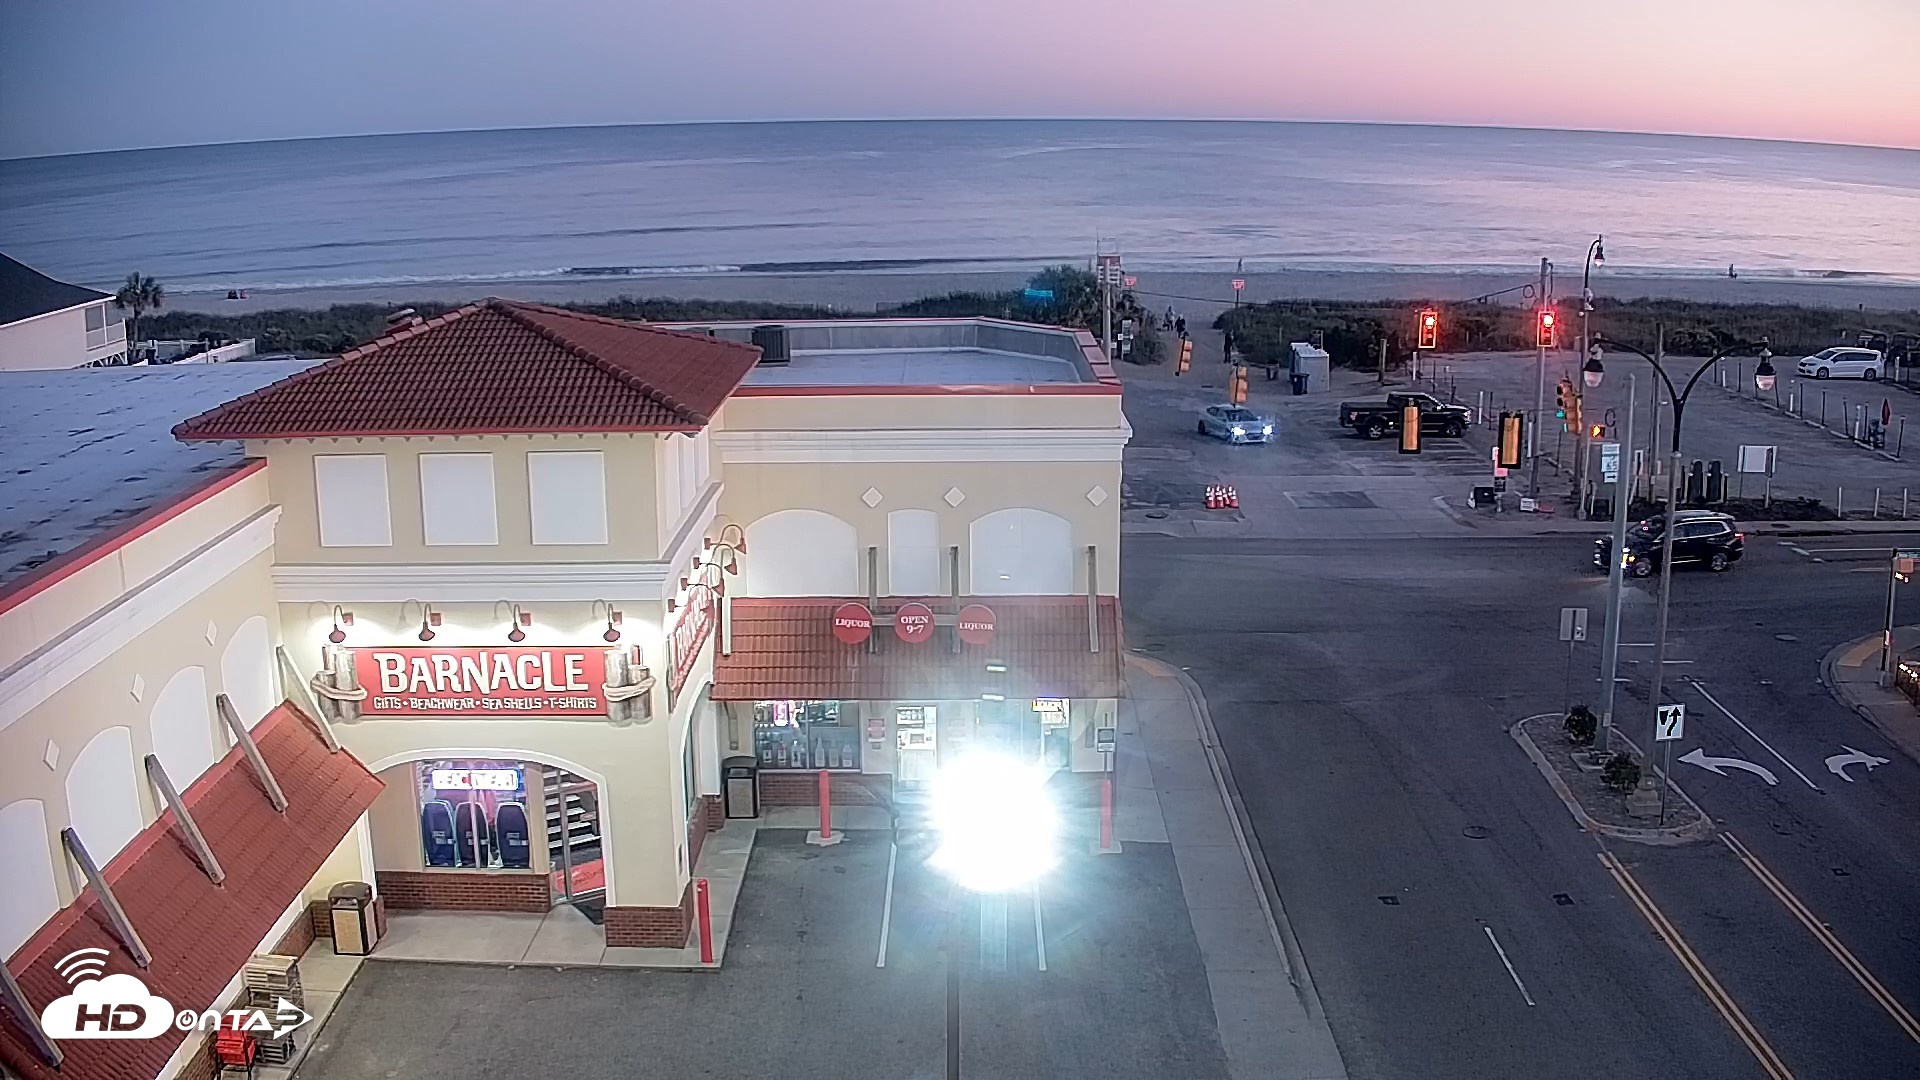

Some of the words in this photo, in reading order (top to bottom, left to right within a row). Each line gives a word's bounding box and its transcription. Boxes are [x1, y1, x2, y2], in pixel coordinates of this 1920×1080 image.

[835, 618, 870, 628] LIQUOR
[900, 616, 929, 624] OPEN
[906, 625, 924, 634] 9-7
[959, 622, 994, 631] LIQUOR
[372, 651, 589, 695] BARNACLE
[373, 697, 402, 710] GIFTS
[408, 697, 476, 711] BEACHWEAR
[481, 698, 503, 710] SEA
[504, 697, 542, 710] SHELLS
[547, 697, 597, 709] T-SHIRTS
